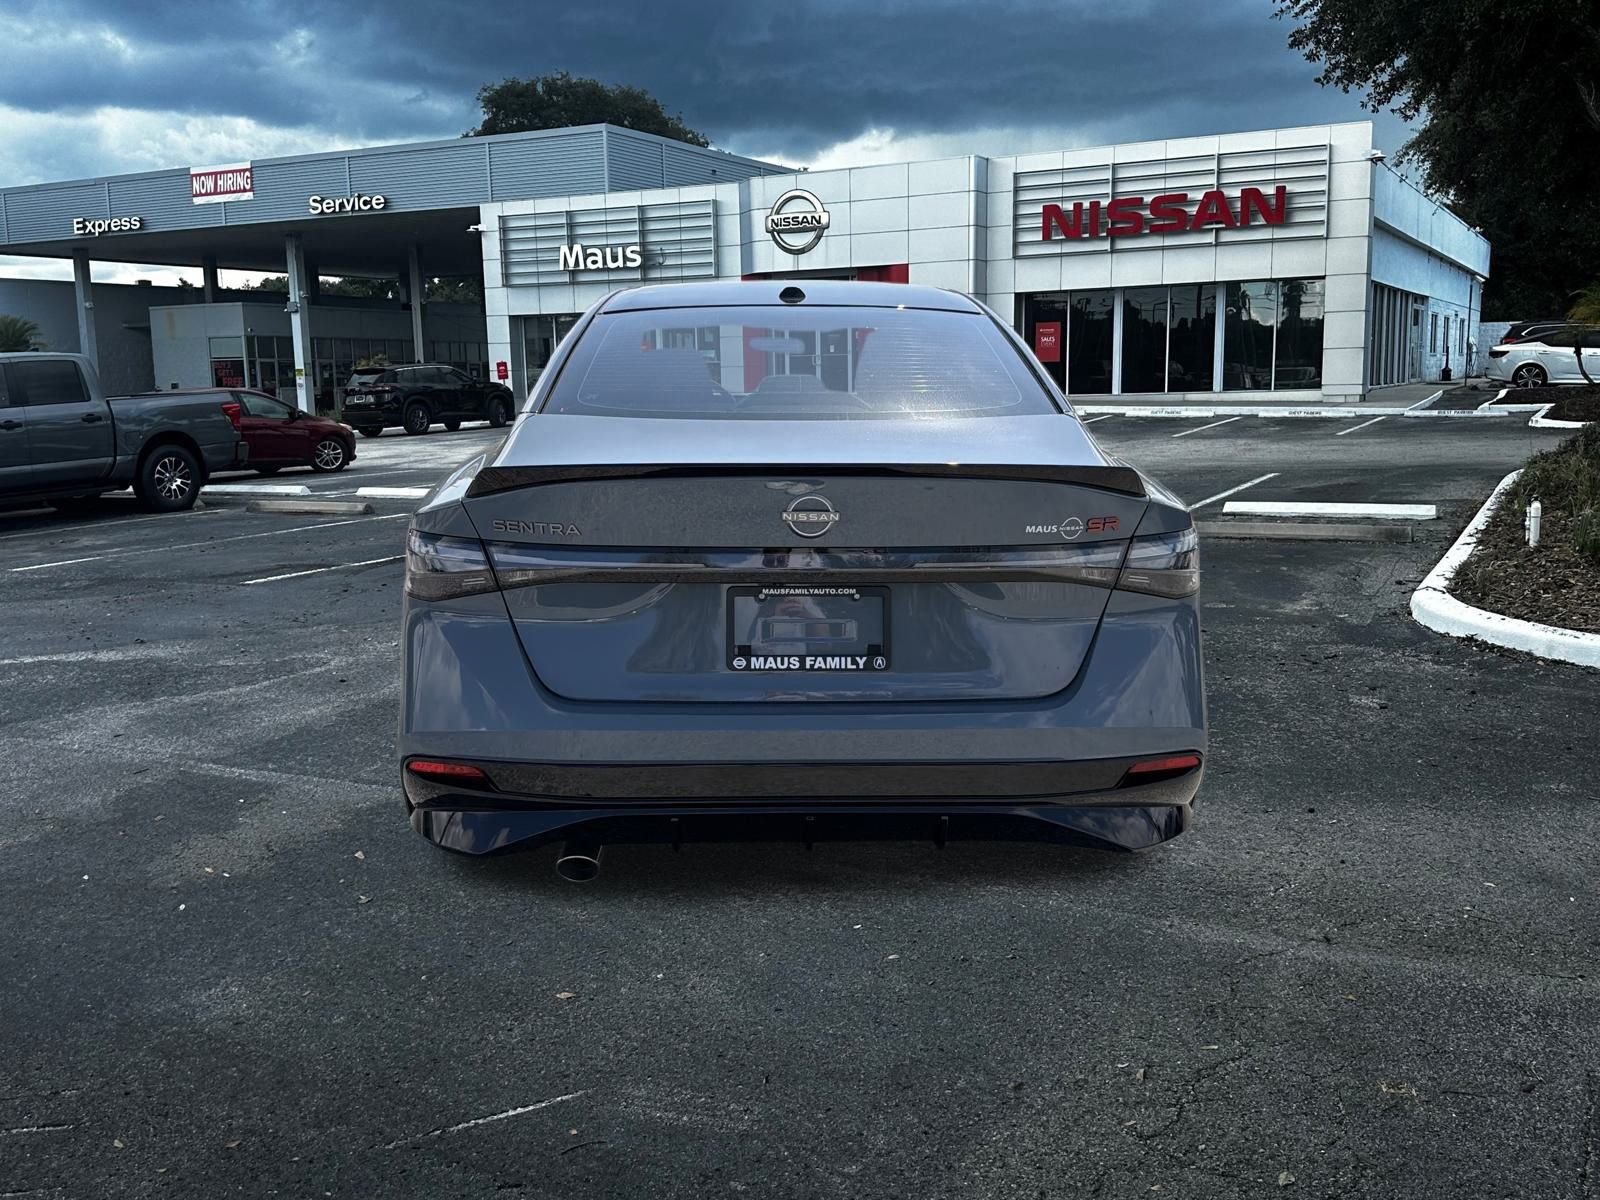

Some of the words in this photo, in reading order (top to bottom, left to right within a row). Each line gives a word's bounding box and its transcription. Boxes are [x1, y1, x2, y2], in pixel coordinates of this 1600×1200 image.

[192, 174, 216, 195] NOW
[217, 171, 251, 192] HIRING
[308, 193, 386, 215] Service
[1041, 184, 1288, 241] NISSAN
[72, 215, 142, 236] Express
[770, 214, 822, 229] NISSAN
[559, 243, 642, 271] Maus
[782, 512, 840, 522] NISSAN
[1025, 525, 1058, 534] MAUS
[1085, 516, 1120, 533] SR
[492, 519, 582, 537] SENTRA
[750, 656, 800, 670] MAUS
[805, 656, 868, 669] FAMILY
